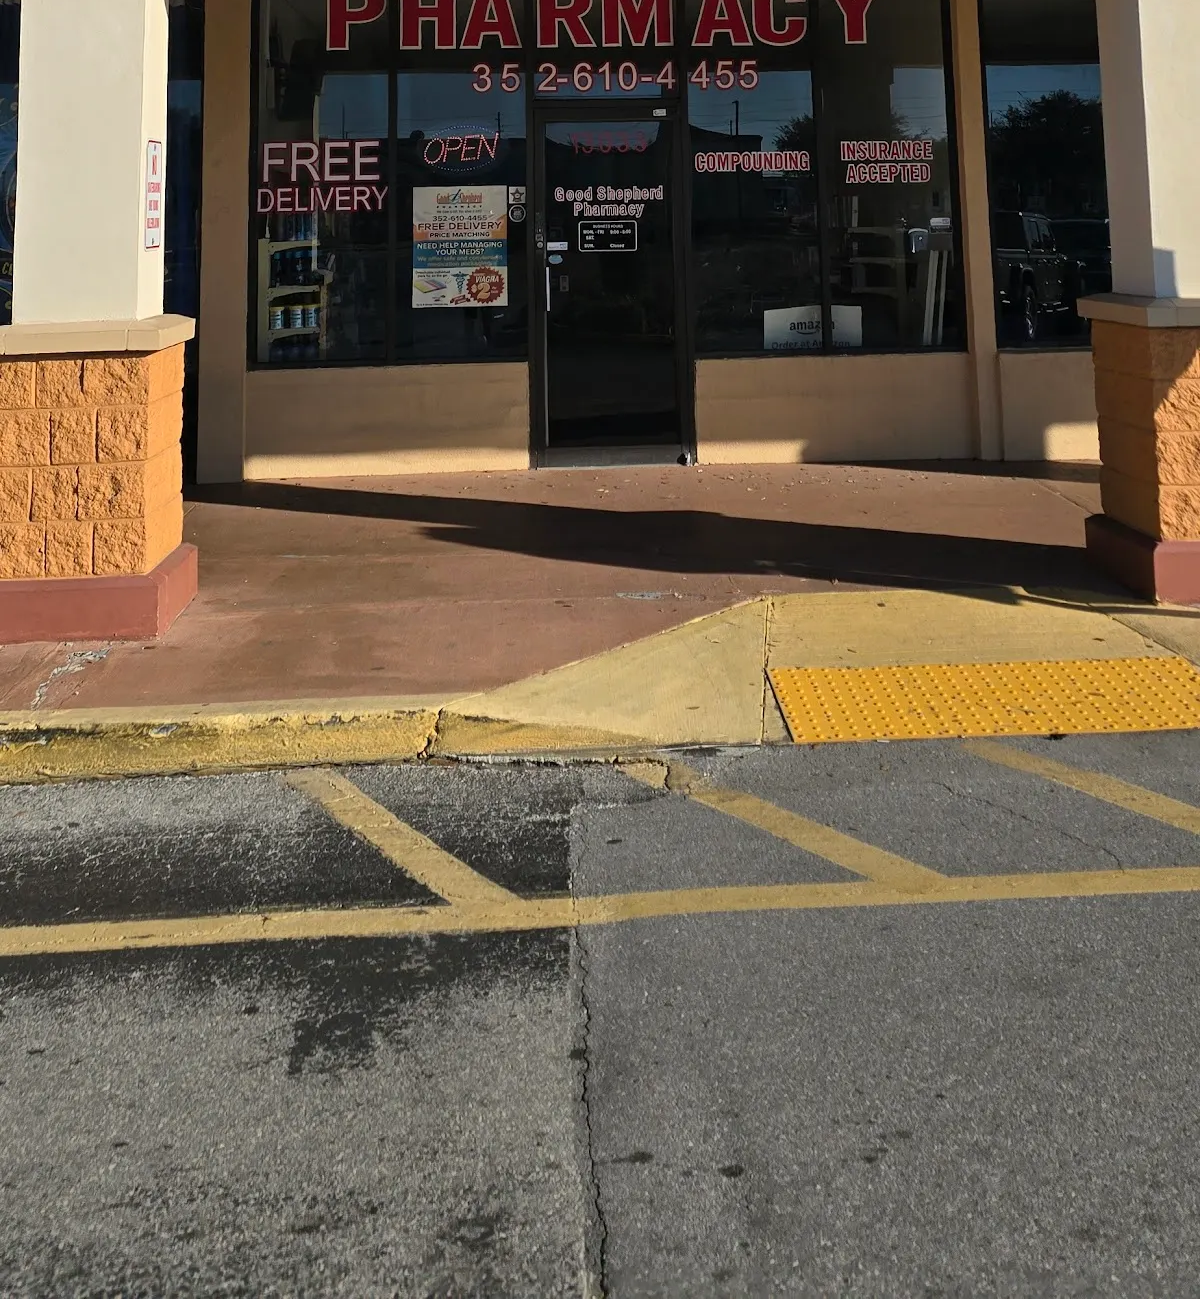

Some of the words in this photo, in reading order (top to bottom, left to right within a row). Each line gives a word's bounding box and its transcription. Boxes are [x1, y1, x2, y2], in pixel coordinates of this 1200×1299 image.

[423, 132, 499, 164] OPEN
[840, 140, 934, 161] INSURANCE
[261, 141, 380, 182] FREE
[695, 151, 811, 172] COMPOUNDING
[846, 163, 931, 183] ACCEPTED
[257, 186, 389, 212] DELIVERY
[554, 187, 593, 202] Good
[596, 185, 664, 202] Shepherd
[573, 202, 645, 218] Pharmacy
[448, 221, 502, 230] DELIVERY
